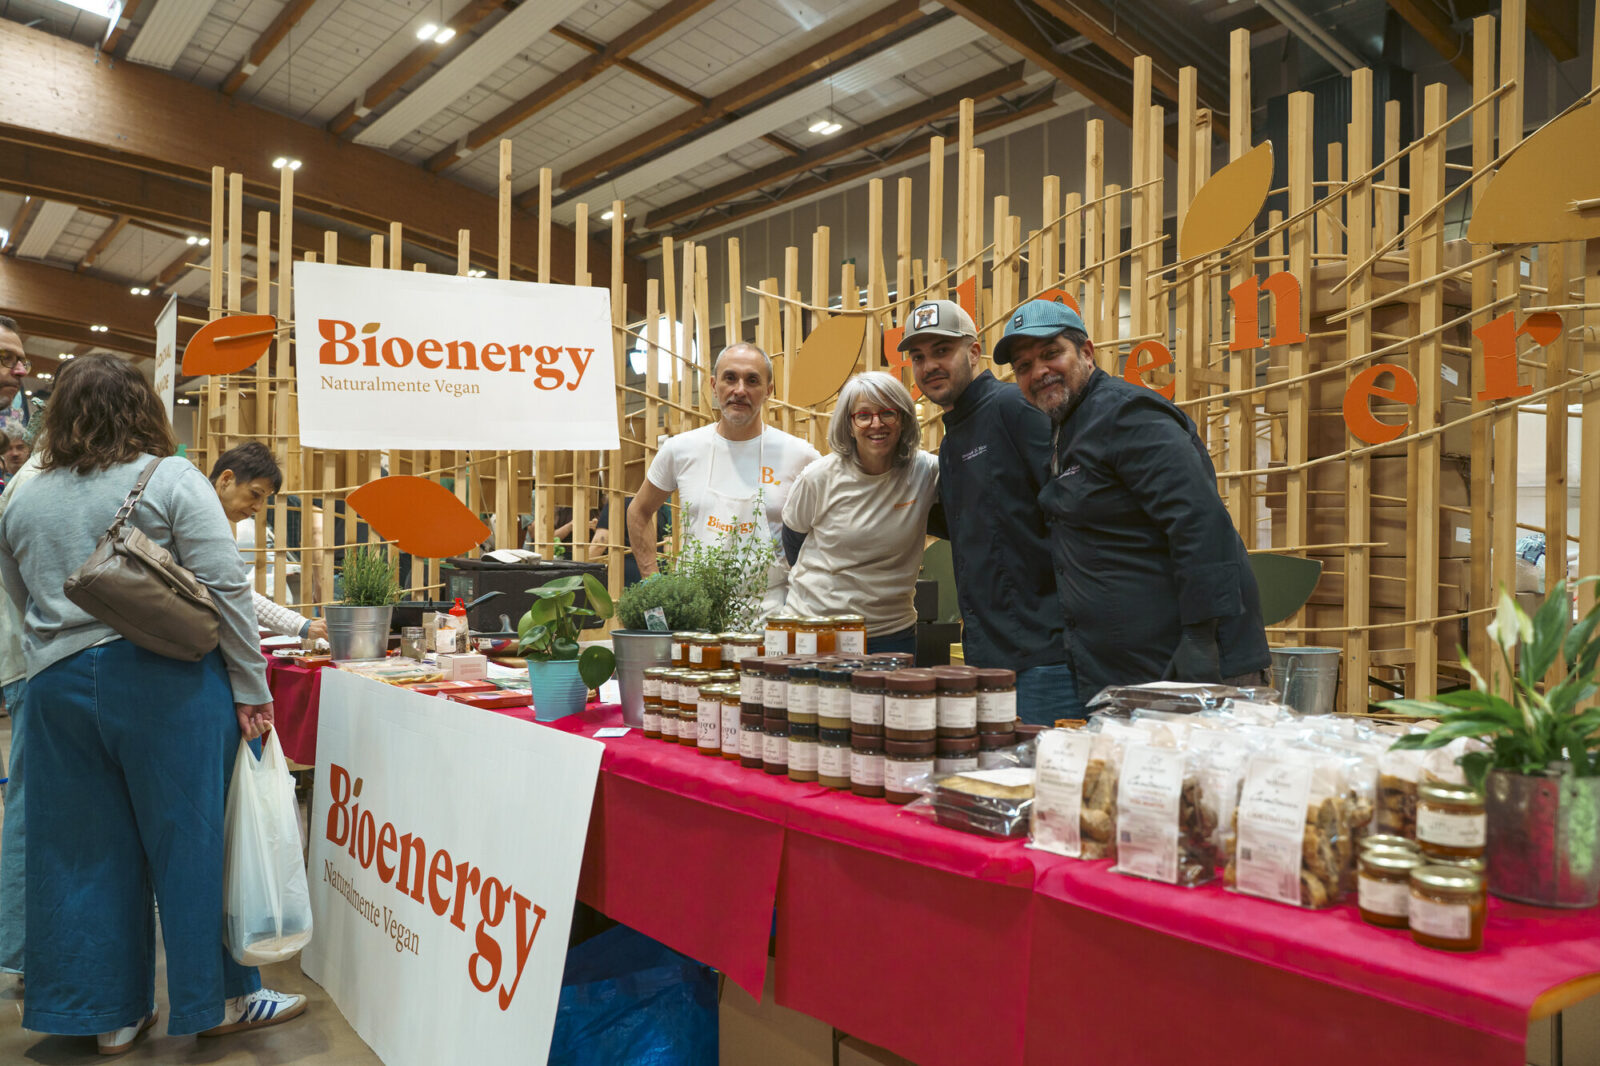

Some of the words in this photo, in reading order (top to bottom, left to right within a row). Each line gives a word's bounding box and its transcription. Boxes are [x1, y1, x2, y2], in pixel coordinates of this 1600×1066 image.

[318, 318, 595, 391] Bioenergy
[320, 375, 431, 393] Naturalmente
[434, 379, 481, 398] Vegan
[323, 858, 381, 928] Naturalmente
[383, 905, 420, 956] Vegan
[326, 763, 547, 1011] Bioenergy
